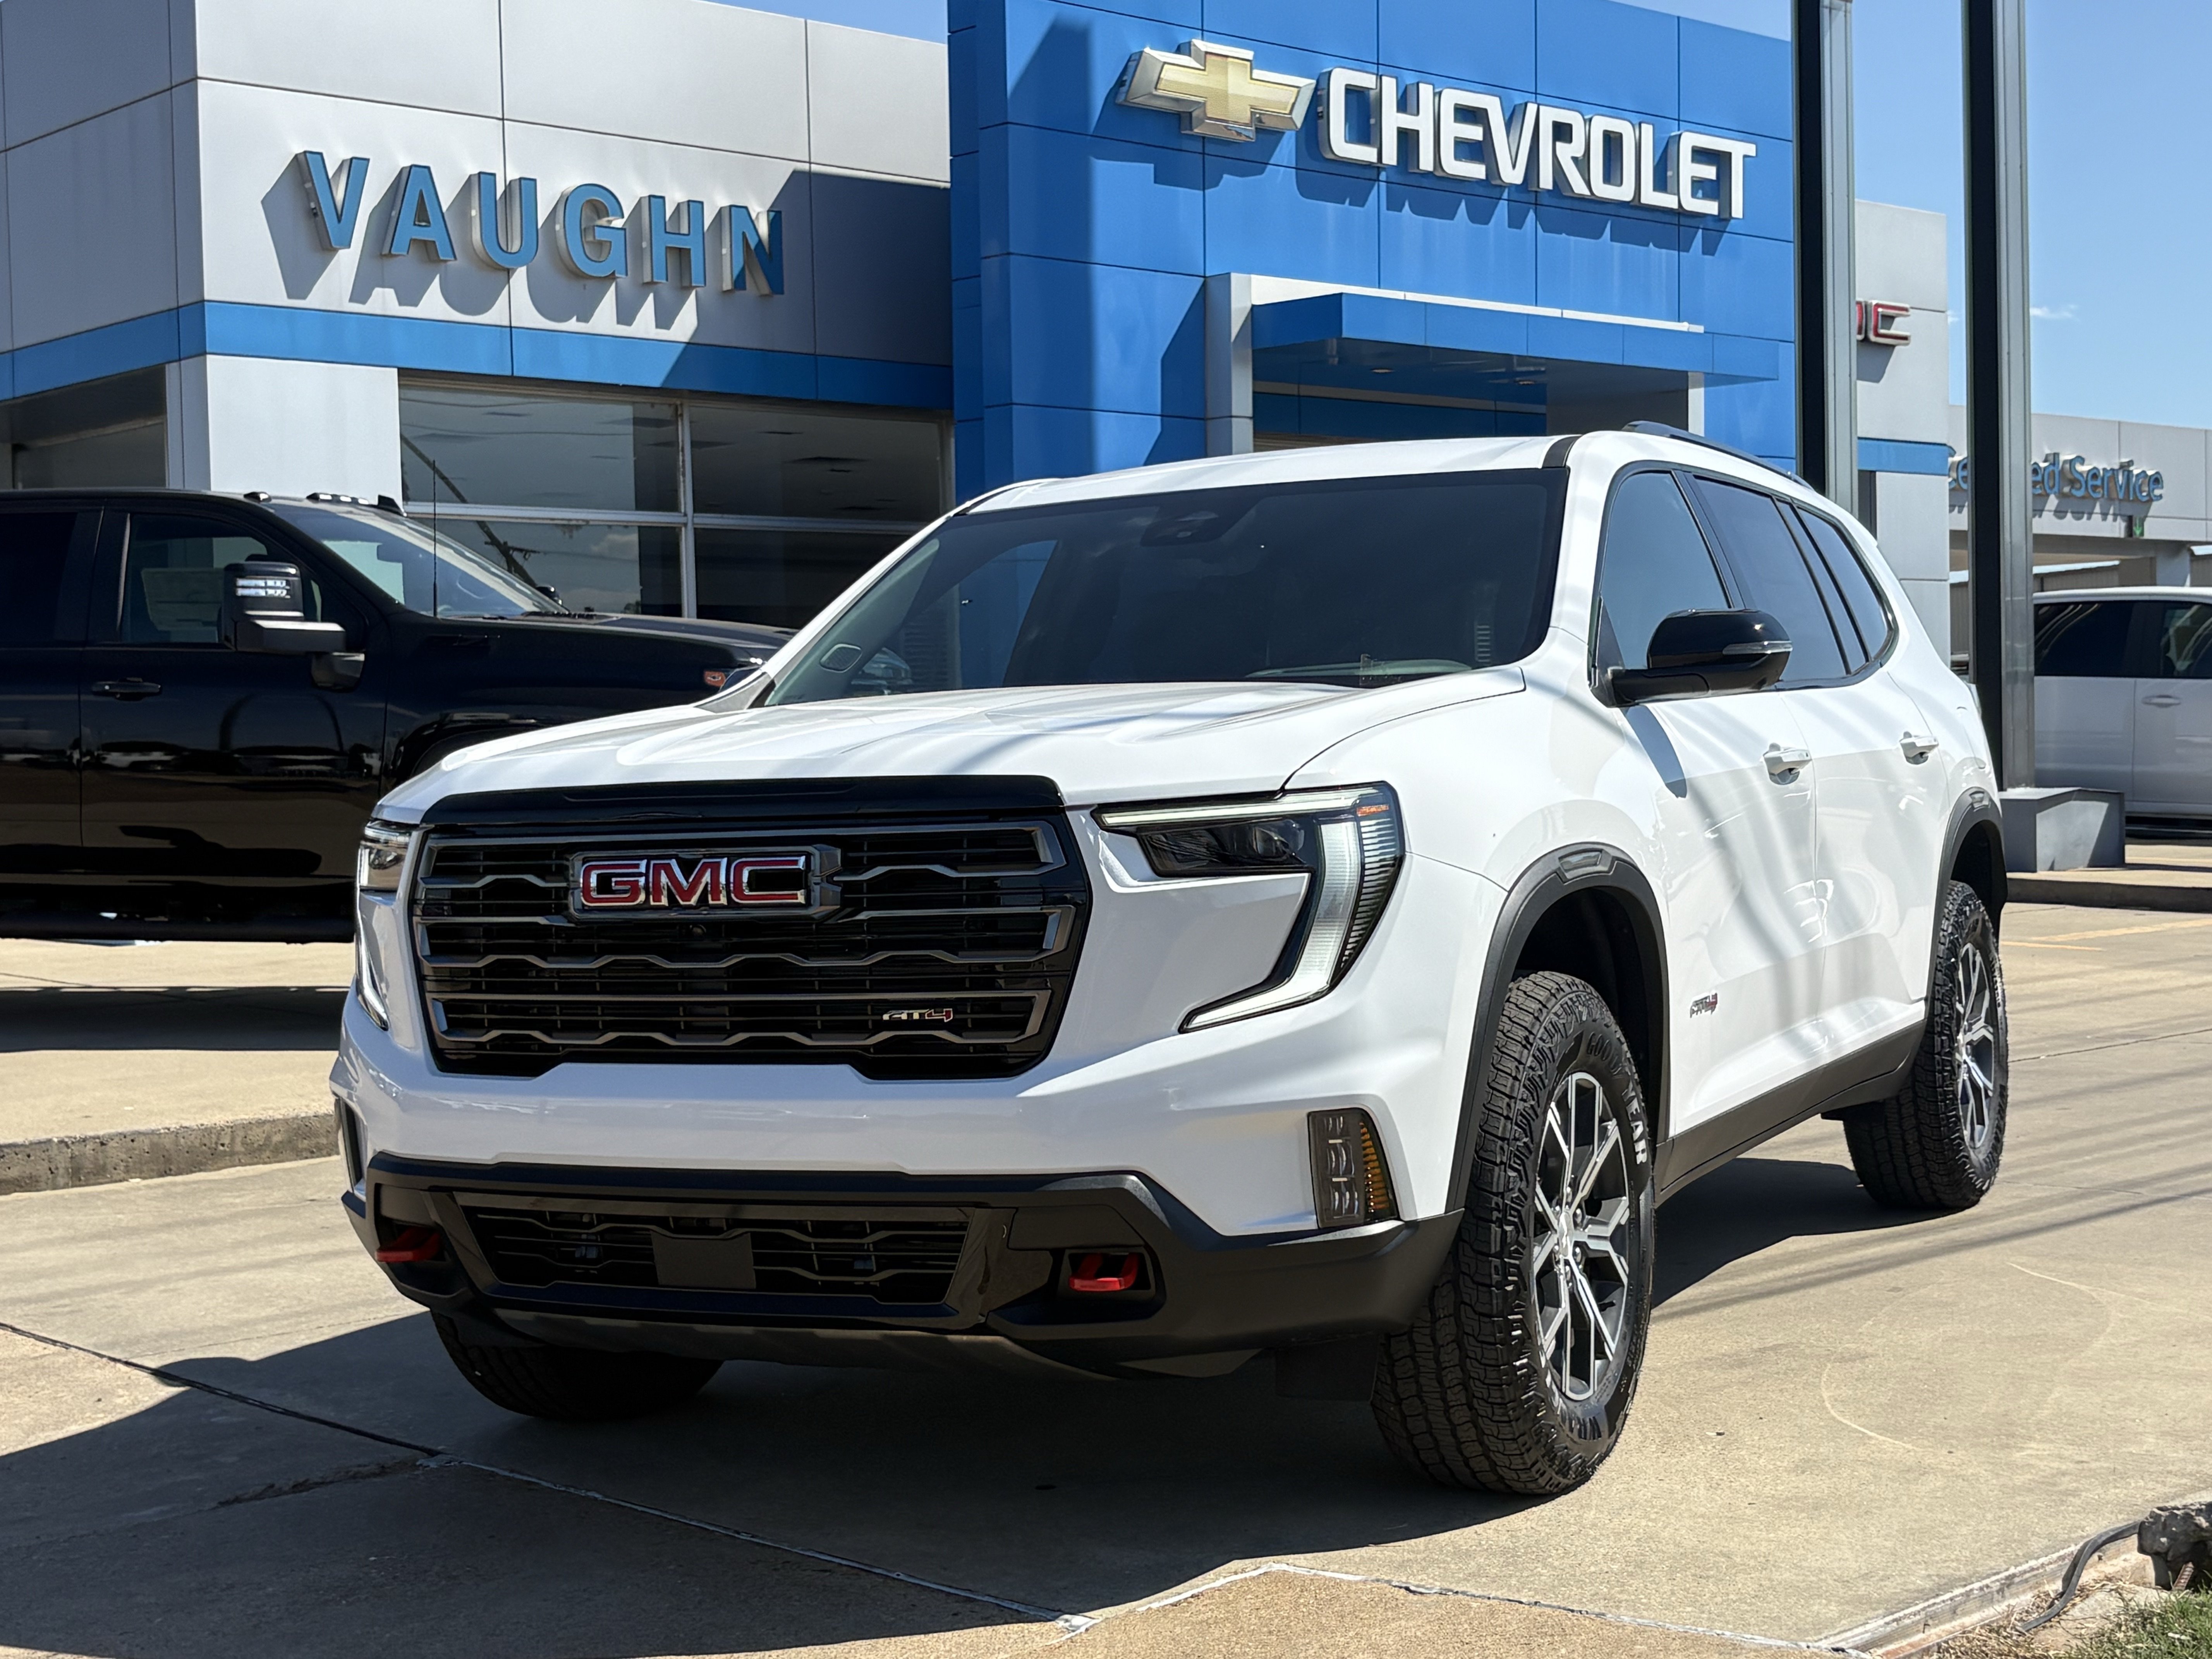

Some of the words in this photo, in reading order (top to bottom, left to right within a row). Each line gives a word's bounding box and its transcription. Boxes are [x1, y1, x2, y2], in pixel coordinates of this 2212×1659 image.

[1320, 67, 1757, 220] CHEVROLET
[297, 150, 784, 295] VAUGHN
[2066, 455, 2164, 502] Service
[580, 856, 806, 907] GMC
